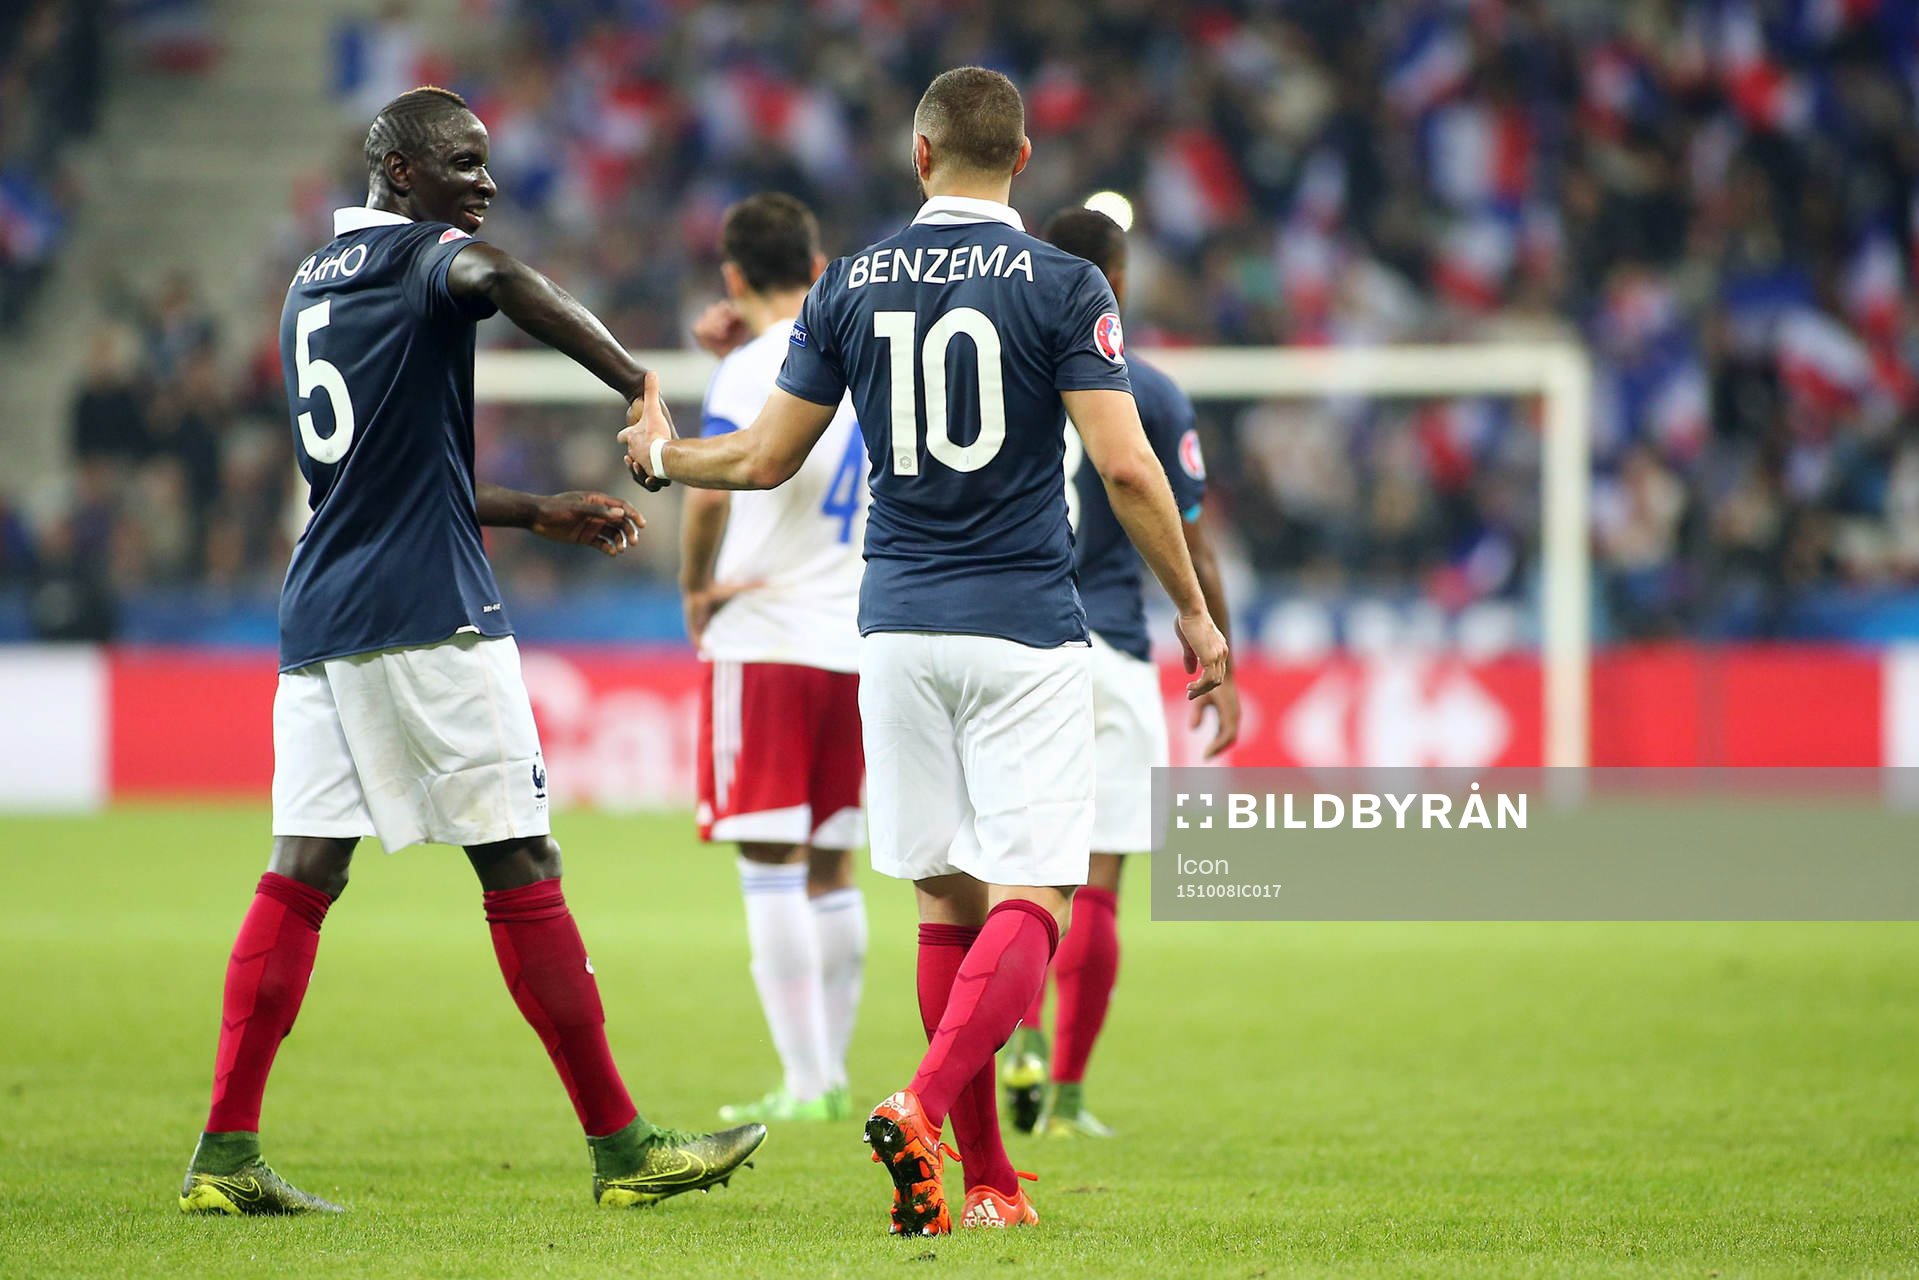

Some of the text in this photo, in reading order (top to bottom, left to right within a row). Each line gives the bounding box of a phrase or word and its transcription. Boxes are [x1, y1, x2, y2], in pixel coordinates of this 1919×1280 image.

[849, 245, 1034, 289] BENZEMA
[295, 300, 355, 465] 5
[873, 307, 1006, 476] 10
[821, 421, 865, 544] 4
[963, 1215, 1006, 1228] adidas
